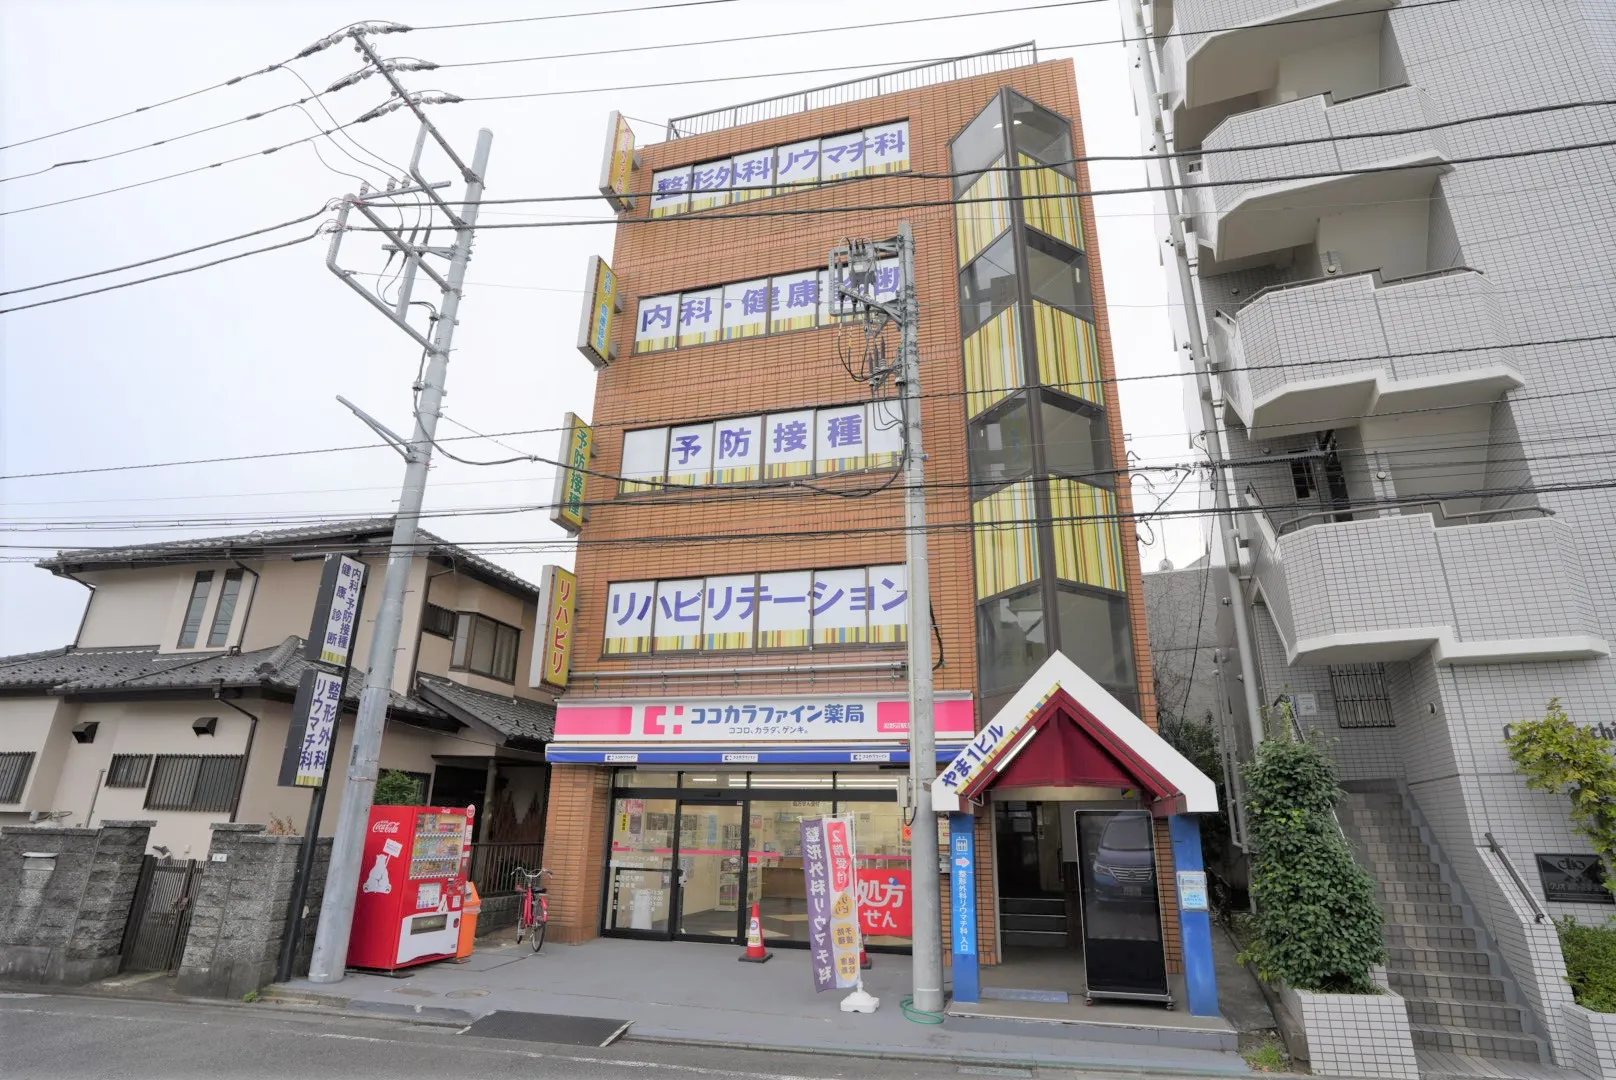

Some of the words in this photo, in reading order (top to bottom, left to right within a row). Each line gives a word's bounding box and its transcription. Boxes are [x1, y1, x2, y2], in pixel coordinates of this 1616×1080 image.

[656, 130, 905, 201] 整形外科リウマチ科
[567, 428, 589, 516] 予防接種
[672, 414, 864, 465] 予防接種
[326, 562, 352, 646] 健康診断
[338, 567, 362, 649] 内科・予防接種
[552, 580, 571, 675] リハビリ
[612, 578, 907, 626] リハビリテーション
[300, 679, 326, 771] リウマチ科
[313, 680, 341, 770] 整形外科
[690, 704, 864, 725] ココカラファイン薬局
[857, 878, 906, 908] 処方
[863, 909, 898, 928] せん
[958, 870, 969, 935] 整形外科リウマチ科
[959, 936, 969, 951] 入口
